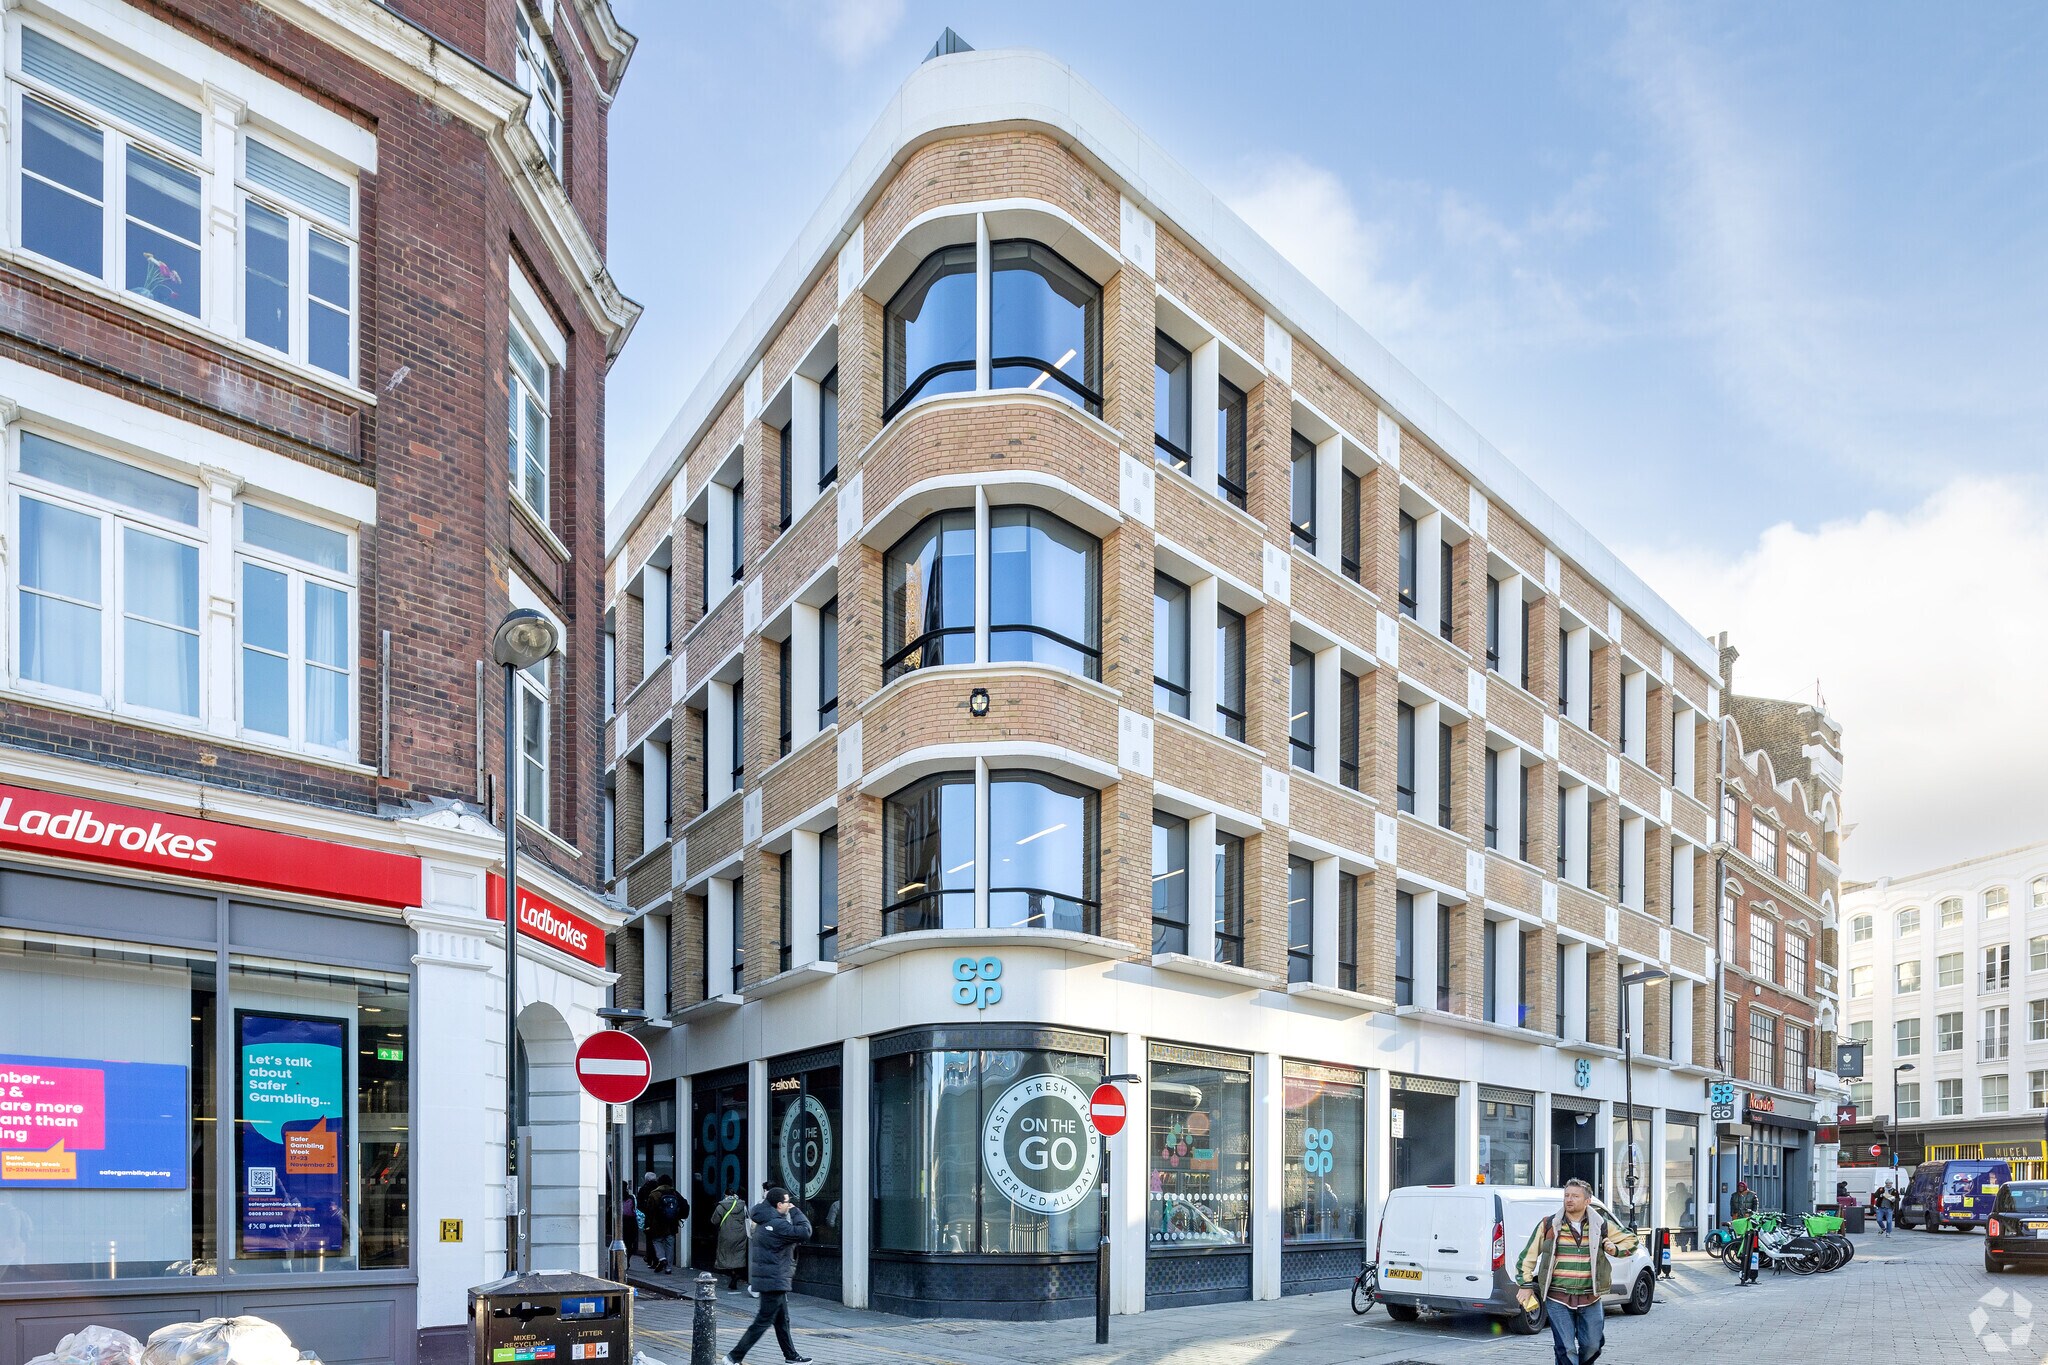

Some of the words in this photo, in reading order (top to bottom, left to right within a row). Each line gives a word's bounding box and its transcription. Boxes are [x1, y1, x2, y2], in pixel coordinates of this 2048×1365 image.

[0, 797, 217, 862] Ladbrokes
[520, 897, 588, 951] Ladbrokes
[249, 1055, 282, 1065] Let's
[286, 1057, 312, 1068] talk
[249, 1068, 292, 1079] about
[9, 1086, 24, 1097] &
[249, 1080, 287, 1091] Safer
[249, 1093, 331, 1107] Gambling...
[0, 1102, 32, 1112] are
[35, 1103, 84, 1114] more
[990, 1106, 1009, 1142] FAST
[1026, 1082, 1067, 1096] FRESH
[1080, 1104, 1097, 1145] FOOD
[1712, 1110, 1731, 1118] GO
[35, 1115, 78, 1127] than
[782, 1122, 790, 1147] FAST
[794, 1101, 812, 1113] FSH
[819, 1113, 829, 1144] FOOD
[1020, 1117, 1047, 1133] ON
[1051, 1119, 1076, 1134] THE
[1018, 1136, 1077, 1171] GO
[784, 1167, 800, 1193] SERVE
[805, 1186, 815, 1194] ALL
[817, 1165, 826, 1184] DAY
[997, 1169, 1047, 1206] SERVED
[1053, 1194, 1073, 1207] ALL
[1075, 1168, 1092, 1194] DAY
[1389, 1270, 1405, 1278] RK17
[1406, 1270, 1420, 1279] UJX
[503, 1340, 546, 1349] RECYCLING
